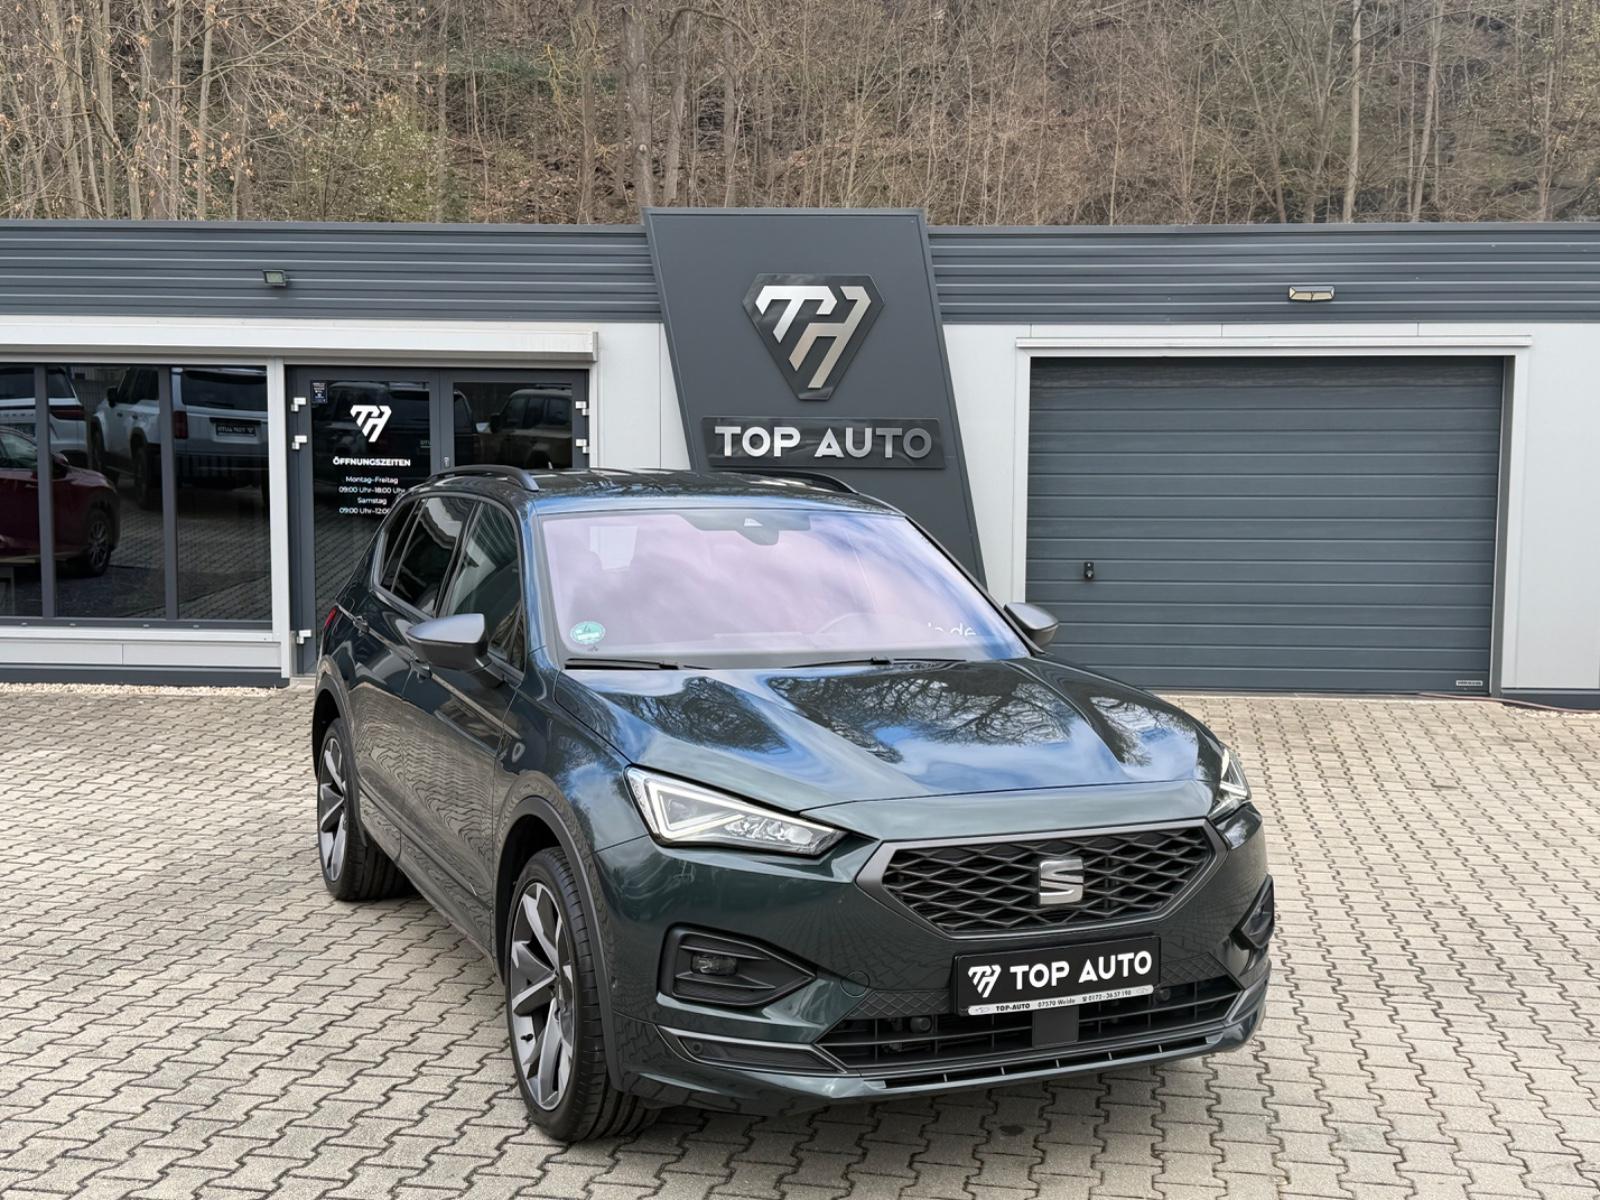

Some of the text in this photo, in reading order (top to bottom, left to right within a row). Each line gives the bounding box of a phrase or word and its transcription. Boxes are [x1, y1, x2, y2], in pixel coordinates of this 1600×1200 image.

[714, 426, 932, 459] TOP AUTO
[332, 456, 411, 467] ÖFFNUNGSZEITEN
[345, 476, 399, 485] Montag-Freitag
[357, 497, 387, 505] Samstag
[1009, 950, 1153, 990] TOP AUTO
[996, 1003, 1031, 1012] TOP-AUTO
